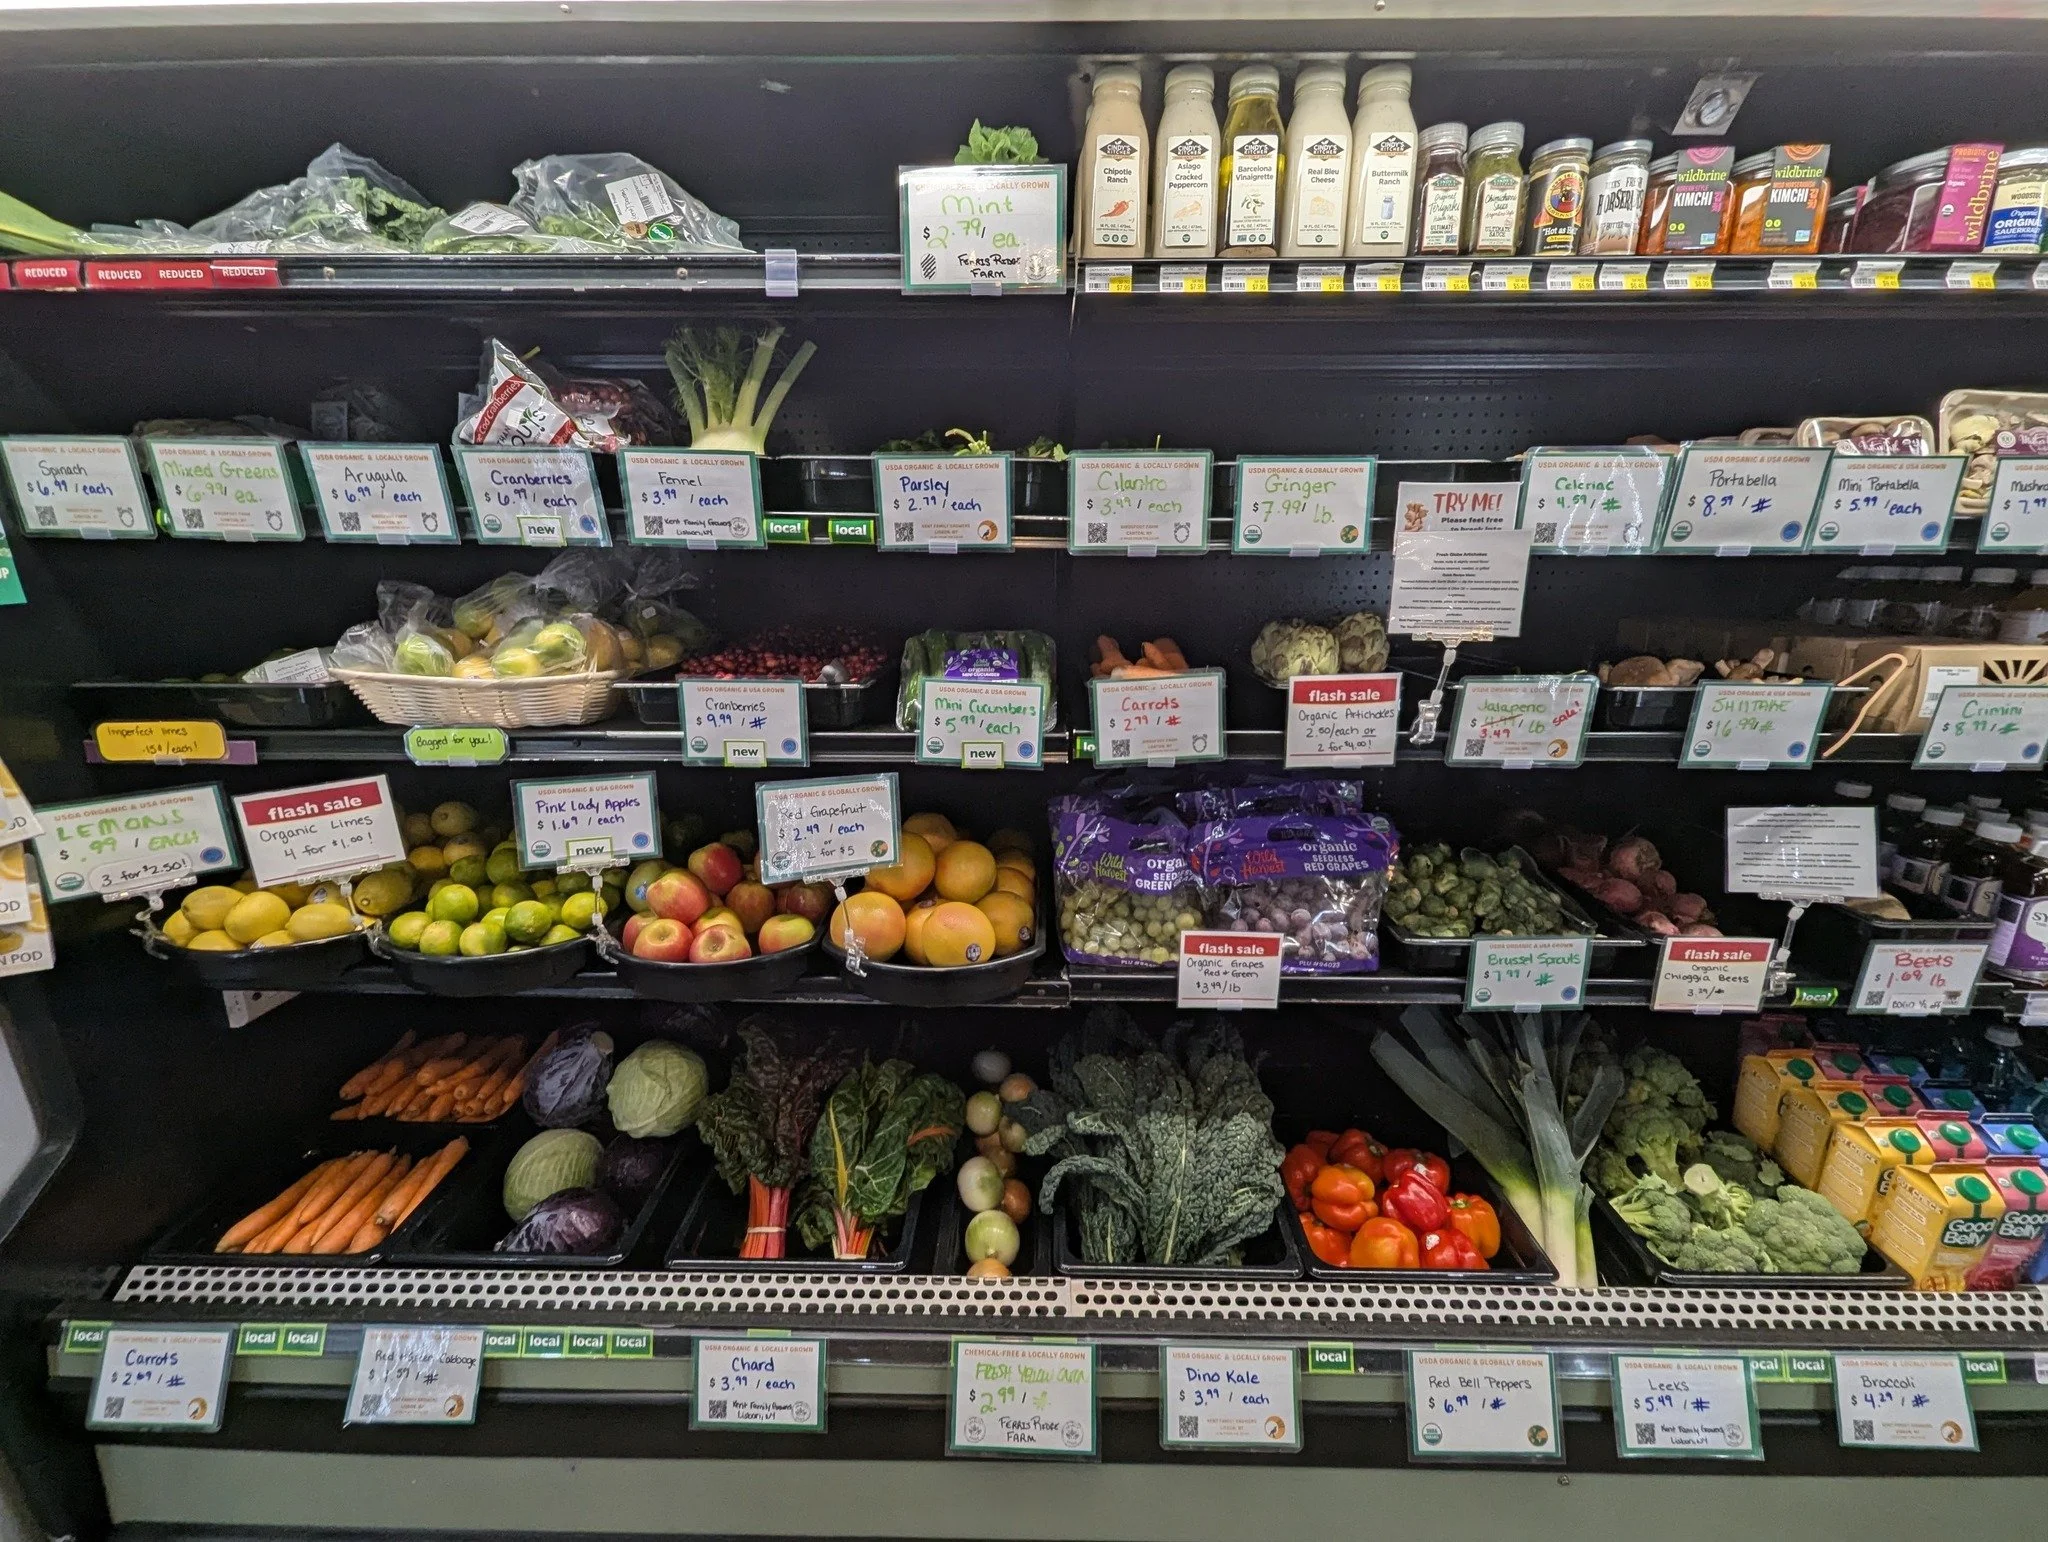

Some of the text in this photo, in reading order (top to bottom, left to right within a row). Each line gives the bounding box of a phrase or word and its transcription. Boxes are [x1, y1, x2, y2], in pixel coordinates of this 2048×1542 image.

[1103, 168, 1133, 177] Chipotle
[1177, 163, 1201, 172] Asiago
[1237, 165, 1272, 173] Barcelona
[1307, 168, 1340, 176] Real Bleu
[1774, 166, 1823, 179] wildbrine
[1106, 175, 1129, 185] Ranch
[1175, 172, 1203, 181] Cracked
[1235, 172, 1274, 182] Vinaigrette
[1310, 176, 1336, 184] Cheese
[1371, 170, 1409, 178] Buttermilk
[1677, 168, 1728, 183] wildbrine
[1021, 181, 1050, 189] GROWN
[1168, 181, 1208, 190] Peppercorn
[1673, 190, 1713, 207] KIMCHI
[1770, 188, 1809, 204] KIMCHI
[1964, 150, 2000, 242] wildbrine
[941, 195, 1014, 215] Mint
[1994, 218, 2043, 229] ORIGINAL
[25, 267, 67, 278] REDUCED
[98, 269, 142, 281] REDUCED
[159, 269, 204, 280] REDUCED
[970, 269, 1006, 279] FARM
[38, 460, 87, 479] Spinach
[162, 461, 279, 479] Mixed Greens
[945, 463, 973, 471] LOCALLY
[1248, 467, 1365, 475] USDA ORGANIC GLOBALLY GROWN
[344, 467, 408, 487] Arugula
[490, 469, 572, 486] Cranberries
[658, 472, 702, 487] Fennel
[1097, 470, 1168, 491] Cilantro
[1709, 468, 1777, 488] Portabella
[82, 482, 114, 497] each
[899, 476, 950, 493] Parsley
[1264, 473, 1337, 499] Ginger
[1555, 477, 1614, 491] Celeriac
[1838, 477, 1920, 492] Mini Portabella
[393, 491, 422, 504] each
[543, 494, 578, 507] each
[698, 495, 728, 507] each
[1433, 492, 1504, 515] TRY ME!
[951, 500, 982, 512] each
[1148, 501, 1183, 513] each
[528, 523, 555, 535] new
[769, 523, 801, 534] local
[835, 524, 867, 536] local
[956, 687, 983, 695] ORGANIC
[1308, 689, 1380, 702] flash sale
[705, 697, 766, 712] Cranberries
[935, 698, 1037, 717] Mini Cucumbers
[1121, 697, 1180, 712] Carrots
[1961, 699, 2023, 719] Crimini
[1298, 708, 1396, 726] Organic Artichokes
[107, 726, 188, 738] Imperfect limes
[986, 722, 1021, 735] each
[1479, 728, 1511, 739] 3.49
[416, 733, 492, 749] Bagged for you!
[1328, 742, 1343, 752] for
[732, 746, 758, 757] new
[969, 748, 996, 759] new
[268, 795, 363, 821] flash sale
[536, 796, 641, 814] Pink Apples
[810, 803, 867, 820] Grapefruit
[56, 809, 184, 842] LEMONS
[597, 814, 625, 826] each
[259, 815, 374, 845] Organic Limes
[837, 822, 865, 835] each
[147, 830, 201, 851] EACH
[302, 843, 327, 857] for
[575, 844, 605, 855] new
[820, 846, 837, 858] for
[1303, 842, 1358, 856] organic
[1312, 855, 1355, 863] SEEDLESS
[1303, 860, 1370, 872] RED GRAPES
[101, 869, 141, 887] 3 for
[1198, 942, 1265, 955] flash sale
[1684, 949, 1752, 960] flash sale
[1186, 957, 1265, 972] Organic Grapes
[1488, 952, 1582, 967] Brussel Sprouts
[1894, 953, 1953, 968] Beets
[1231, 969, 1259, 979] Green
[1691, 964, 1729, 973] Organic
[1664, 973, 1750, 985] Chioggia Beets
[1802, 992, 1831, 1002] local
[1948, 1218, 1997, 1232] Good
[1999, 1222, 2041, 1239] Belly
[1944, 1230, 1986, 1247] Belly
[73, 1330, 104, 1341] local
[245, 1331, 276, 1343] local
[287, 1332, 319, 1344] local
[486, 1334, 516, 1346] local
[529, 1335, 560, 1347] local
[572, 1335, 604, 1347] local
[615, 1335, 646, 1347] local
[125, 1349, 178, 1367] Carrots
[964, 1349, 1086, 1361] CHEMICAL-FREE LOCALLY GROWN
[1173, 1352, 1190, 1360] USDA
[1191, 1353, 1222, 1361] ORGANIC
[1315, 1350, 1347, 1363] local
[732, 1357, 775, 1372] Chard
[1438, 1358, 1471, 1366] ORGANIC
[1480, 1359, 1515, 1367] GLOBALLY
[1516, 1360, 1544, 1368] GROWN
[1792, 1359, 1825, 1371] local
[1966, 1360, 1999, 1372] local
[1186, 1367, 1260, 1384] Dino Kale
[766, 1378, 796, 1391] each
[1429, 1376, 1533, 1391] Red Bell Peppers
[1648, 1379, 1690, 1392] Leeks
[1860, 1375, 1917, 1389] Broccoli
[1242, 1394, 1270, 1405] each
[1007, 1432, 1037, 1443] FARM
